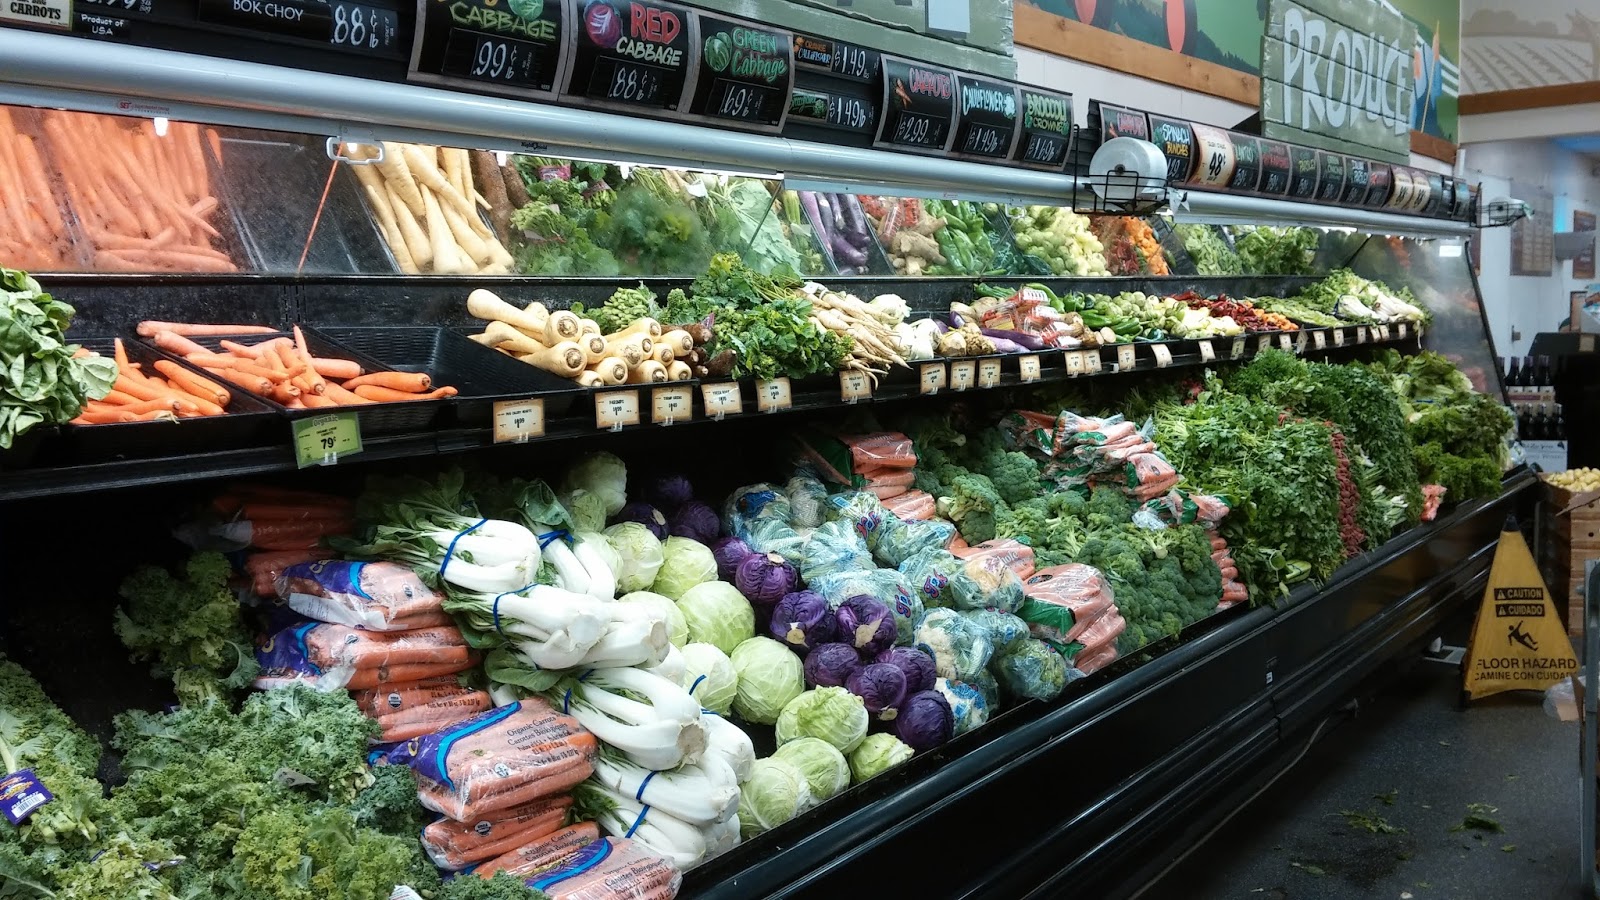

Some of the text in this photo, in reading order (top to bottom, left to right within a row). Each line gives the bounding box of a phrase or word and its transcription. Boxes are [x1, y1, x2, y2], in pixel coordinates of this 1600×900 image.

[10, 2, 61, 20] CARROTS
[81, 13, 113, 26] Product
[233, 0, 304, 21] BOK CHOY
[449, 1, 557, 40] CABBAGE
[91, 25, 114, 36] USA
[629, 1, 681, 45] RED
[615, 36, 683, 67] CABBAGE
[732, 27, 777, 55] GREEN
[731, 50, 788, 83] Cabbage
[1283, 8, 1410, 136] PRODUCE
[908, 67, 952, 100] CARROTS
[1026, 93, 1067, 122] BROCCOLI
[1162, 123, 1190, 146] SPINACH
[1166, 141, 1189, 157] BUNCHES
[1507, 588, 1543, 598] CAUTION
[1508, 605, 1544, 616] CUIDADO
[1476, 658, 1577, 670] FLOOR HAZARD
[1513, 671, 1535, 681] CON
[1536, 671, 1577, 681] CUIDA
[506, 716, 557, 737] Organic Carrots
[507, 732, 535, 746] Carottes
[550, 829, 577, 843] Carrots
